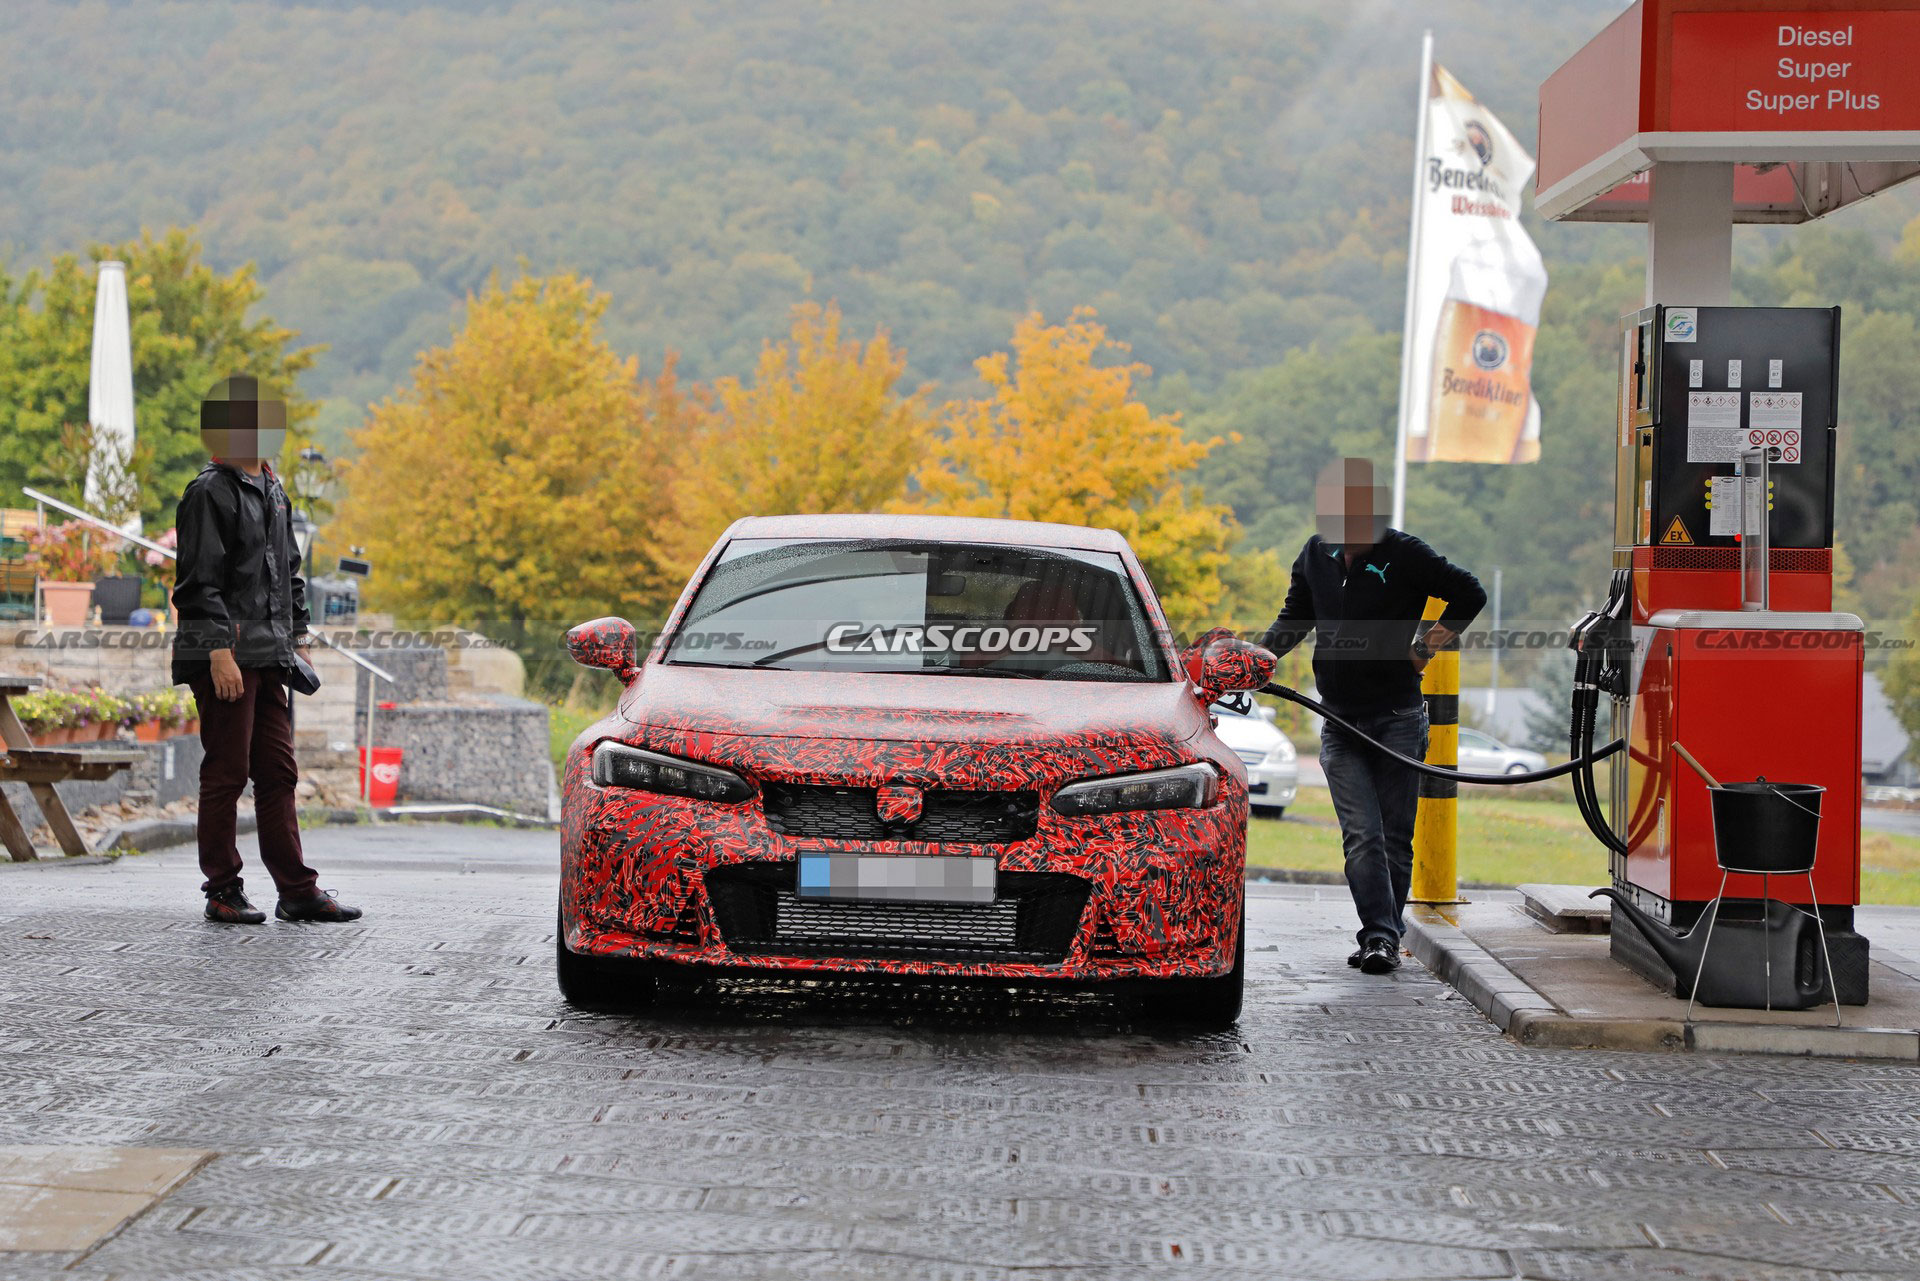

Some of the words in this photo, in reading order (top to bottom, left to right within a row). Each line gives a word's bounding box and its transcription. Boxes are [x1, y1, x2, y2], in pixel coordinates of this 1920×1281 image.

[1778, 25, 1853, 46] Diesel
[1777, 57, 1852, 83] Super
[1745, 89, 1820, 115] Super
[1827, 89, 1881, 110] Plus
[1670, 530, 1683, 541] EX
